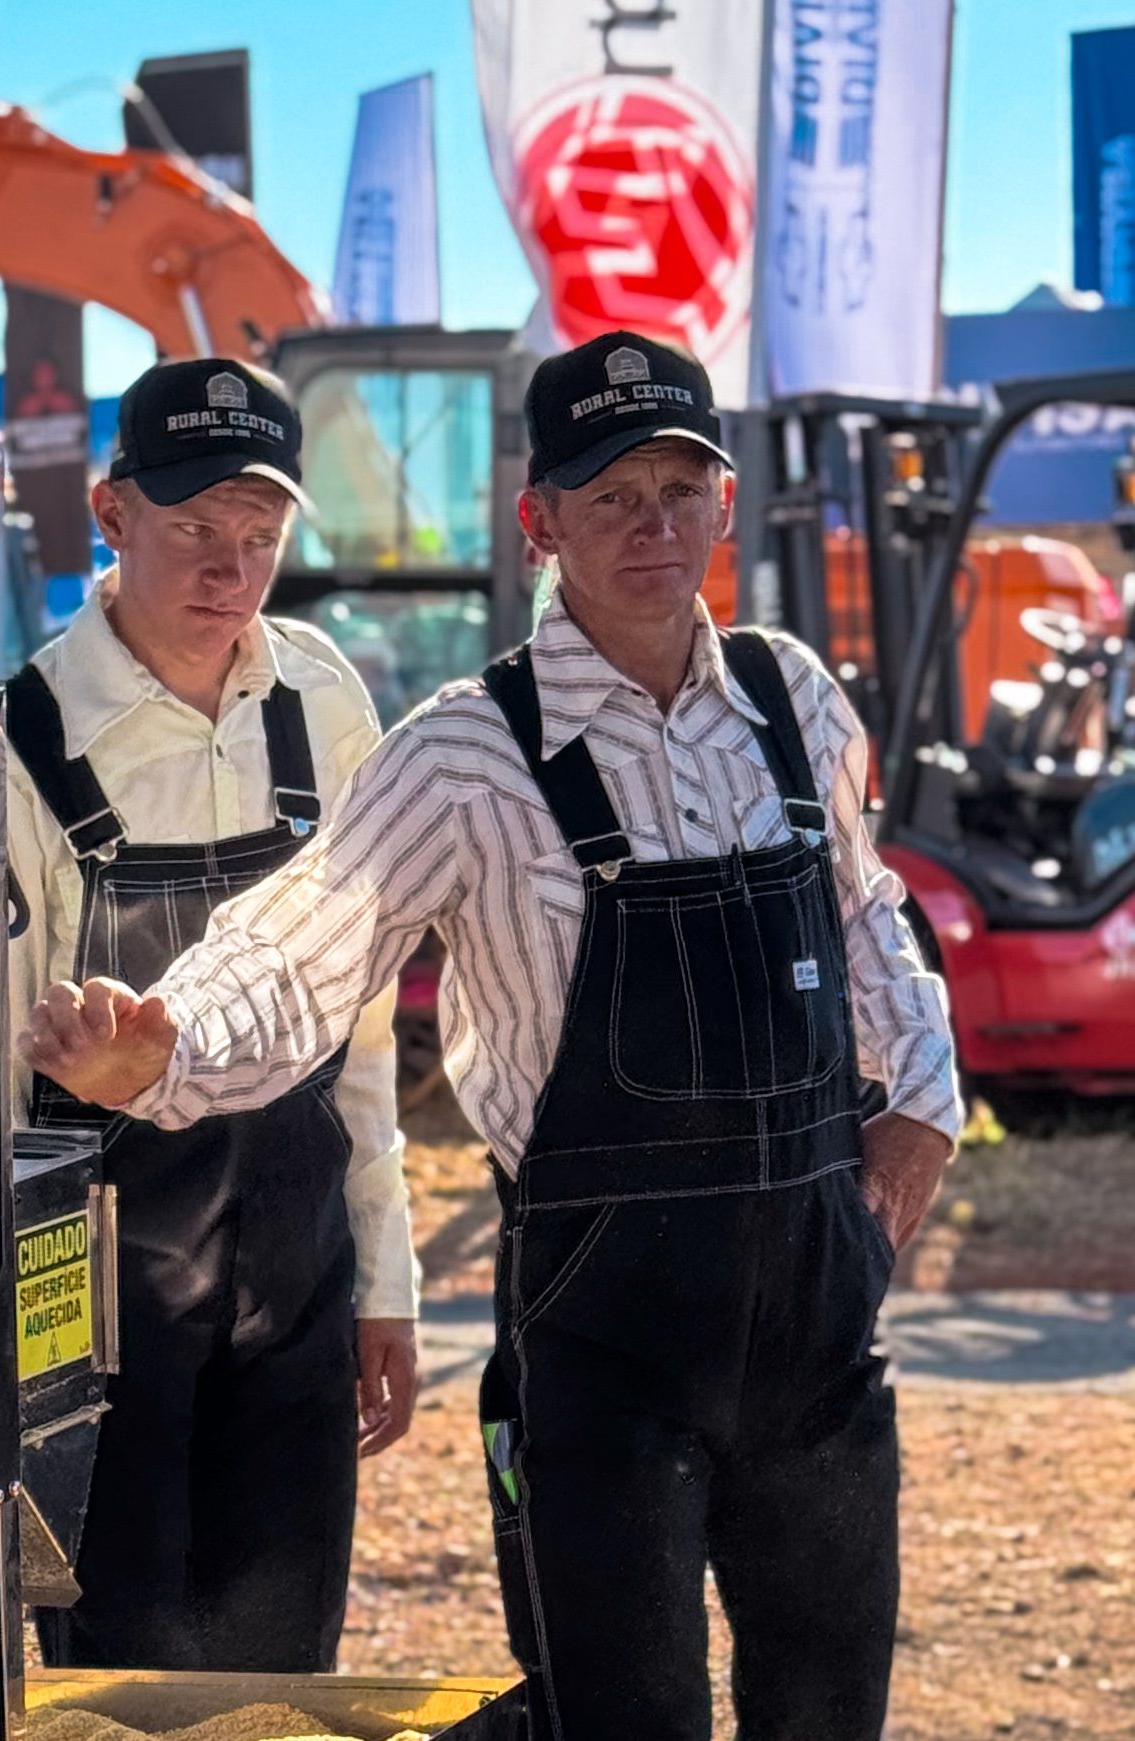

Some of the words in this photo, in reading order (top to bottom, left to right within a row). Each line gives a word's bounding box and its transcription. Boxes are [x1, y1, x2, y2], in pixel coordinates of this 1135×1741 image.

[570, 388, 626, 421] RURAL
[632, 384, 694, 406] CENTER
[167, 410, 222, 432] RURAL
[228, 411, 284, 441] CENTER
[18, 1221, 86, 1276] CUIDADO
[19, 1266, 86, 1312] SUPERFÍCIE
[24, 1297, 83, 1340] AQUECIDA
